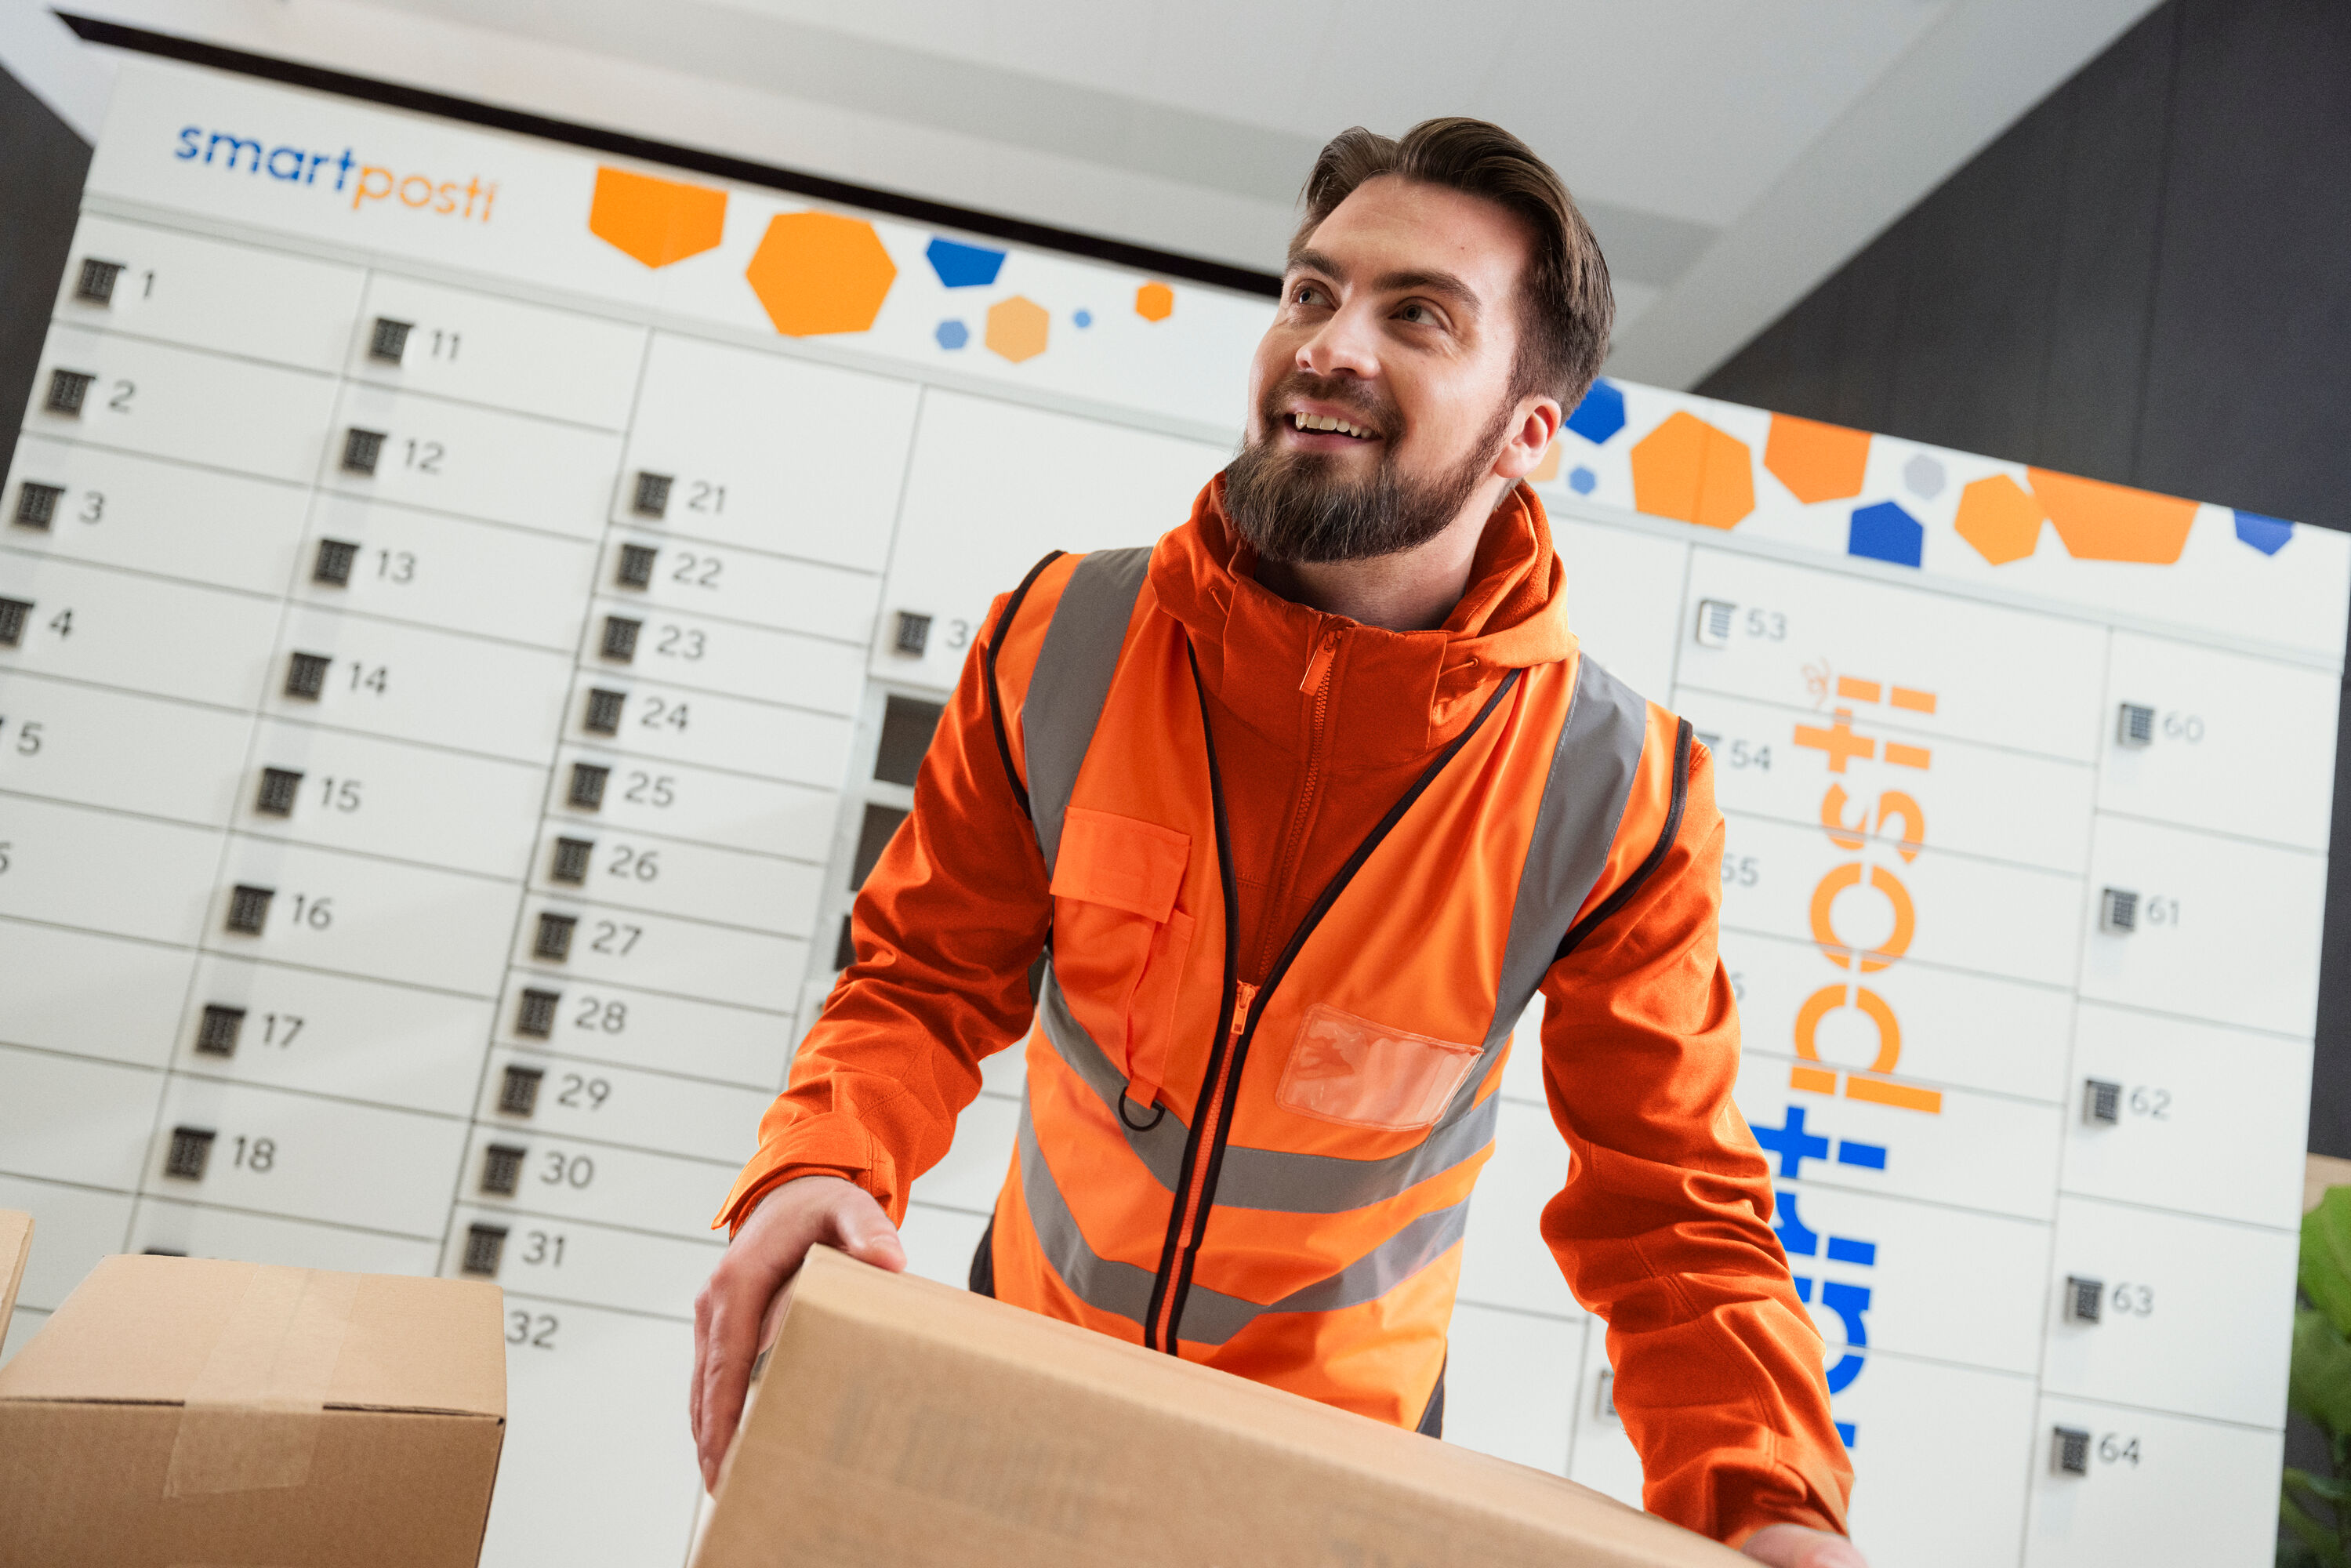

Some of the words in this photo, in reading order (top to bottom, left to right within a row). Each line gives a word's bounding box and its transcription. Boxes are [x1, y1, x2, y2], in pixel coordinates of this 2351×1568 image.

[174, 125, 497, 223] smartposti
[143, 270, 156, 299] 1
[431, 328, 462, 361] 11
[107, 379, 137, 413] 2
[405, 437, 445, 474] 12
[78, 491, 107, 525] 3
[686, 480, 727, 514] 21
[377, 548, 417, 584] 13
[670, 550, 724, 590] 22
[49, 608, 74, 639] 4
[945, 617, 981, 652] 3
[1745, 607, 1788, 643] 53
[655, 624, 707, 662] 23
[350, 661, 389, 695] 14
[640, 697, 690, 731] 24
[2162, 710, 2206, 745] 60
[16, 720, 43, 757] 5
[1730, 739, 1772, 772] 54
[321, 775, 361, 813] 15
[622, 770, 675, 809] 25
[607, 844, 659, 883] 26
[292, 893, 332, 931] 16
[2145, 895, 2180, 926] 61
[590, 919, 644, 957] 27
[263, 1012, 306, 1048] 17
[573, 996, 629, 1036] 28
[556, 1073, 612, 1110] 29
[2128, 1086, 2171, 1120] 62
[234, 1134, 277, 1174] 18
[539, 1150, 596, 1191] 30
[522, 1230, 567, 1267] 31
[2110, 1283, 2153, 1317] 63
[504, 1309, 560, 1350] 32
[2095, 1431, 2143, 1468] 64
